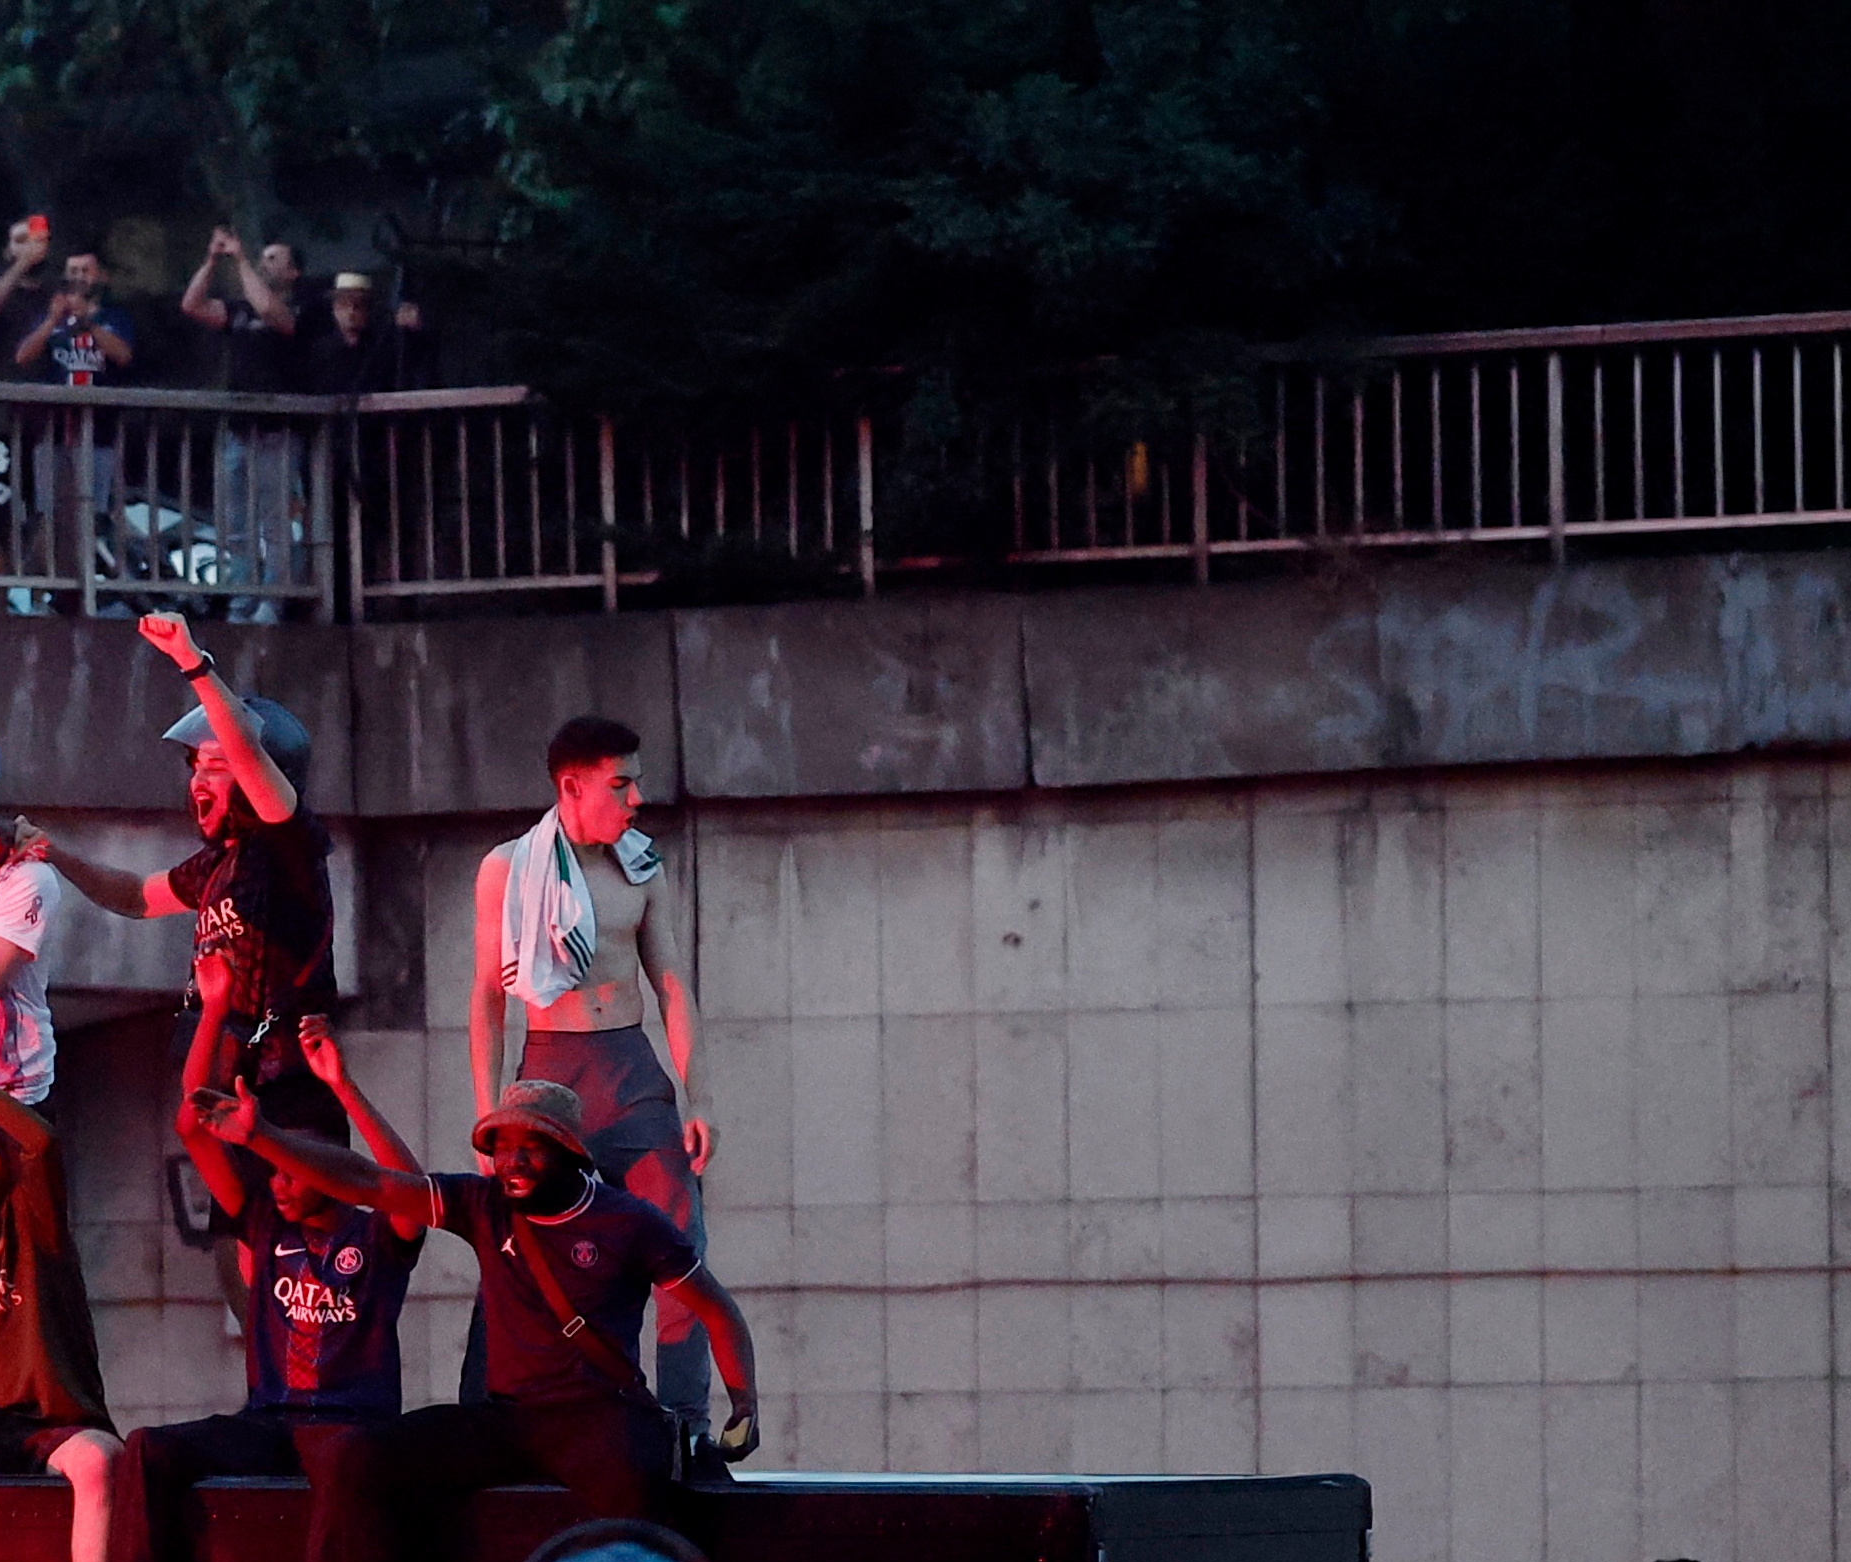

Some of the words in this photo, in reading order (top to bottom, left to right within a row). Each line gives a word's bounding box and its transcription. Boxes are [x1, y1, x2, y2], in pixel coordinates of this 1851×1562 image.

[197, 897, 239, 936] TAR
[273, 1276, 353, 1307] QATAR
[285, 1305, 357, 1324] AIRWAYS
